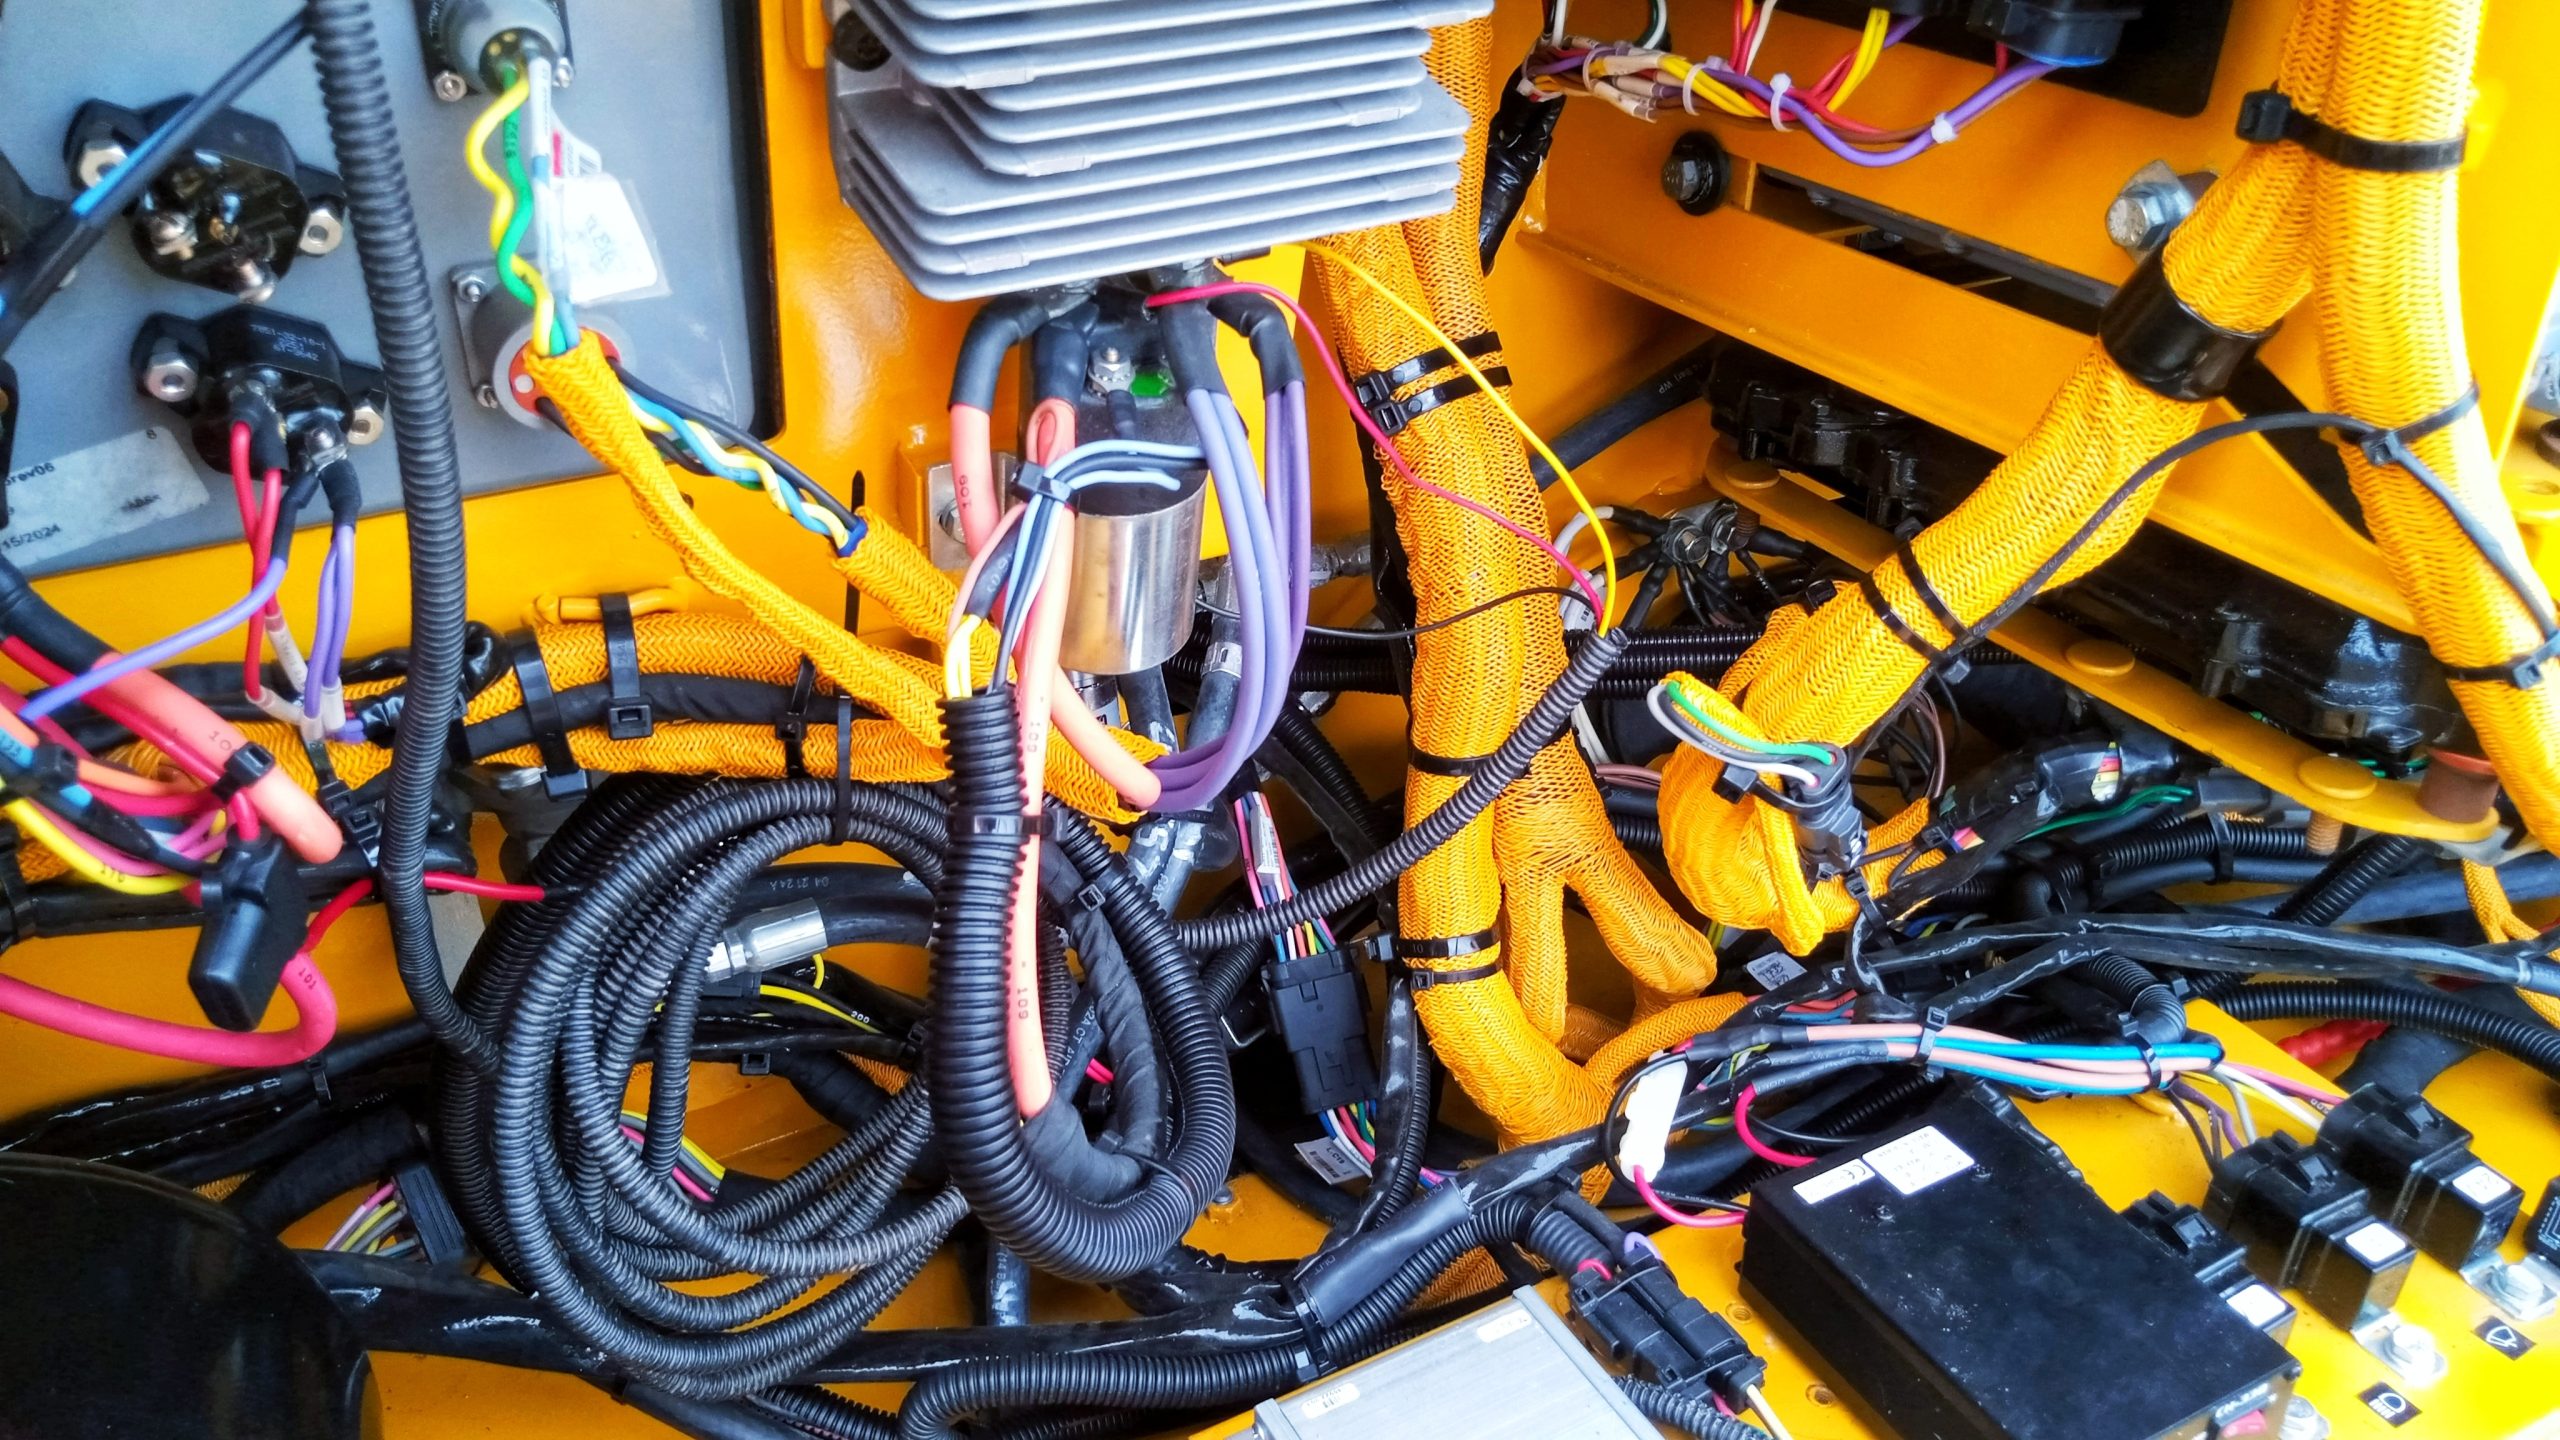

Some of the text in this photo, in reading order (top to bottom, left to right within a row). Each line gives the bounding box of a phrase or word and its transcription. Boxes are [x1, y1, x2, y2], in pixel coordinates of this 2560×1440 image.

[146, 429, 157, 439] 8
[209, 730, 232, 751] 10
[298, 968, 317, 990] 101
[1017, 986, 1029, 1020] 109
[1073, 1027, 1086, 1044] CT
